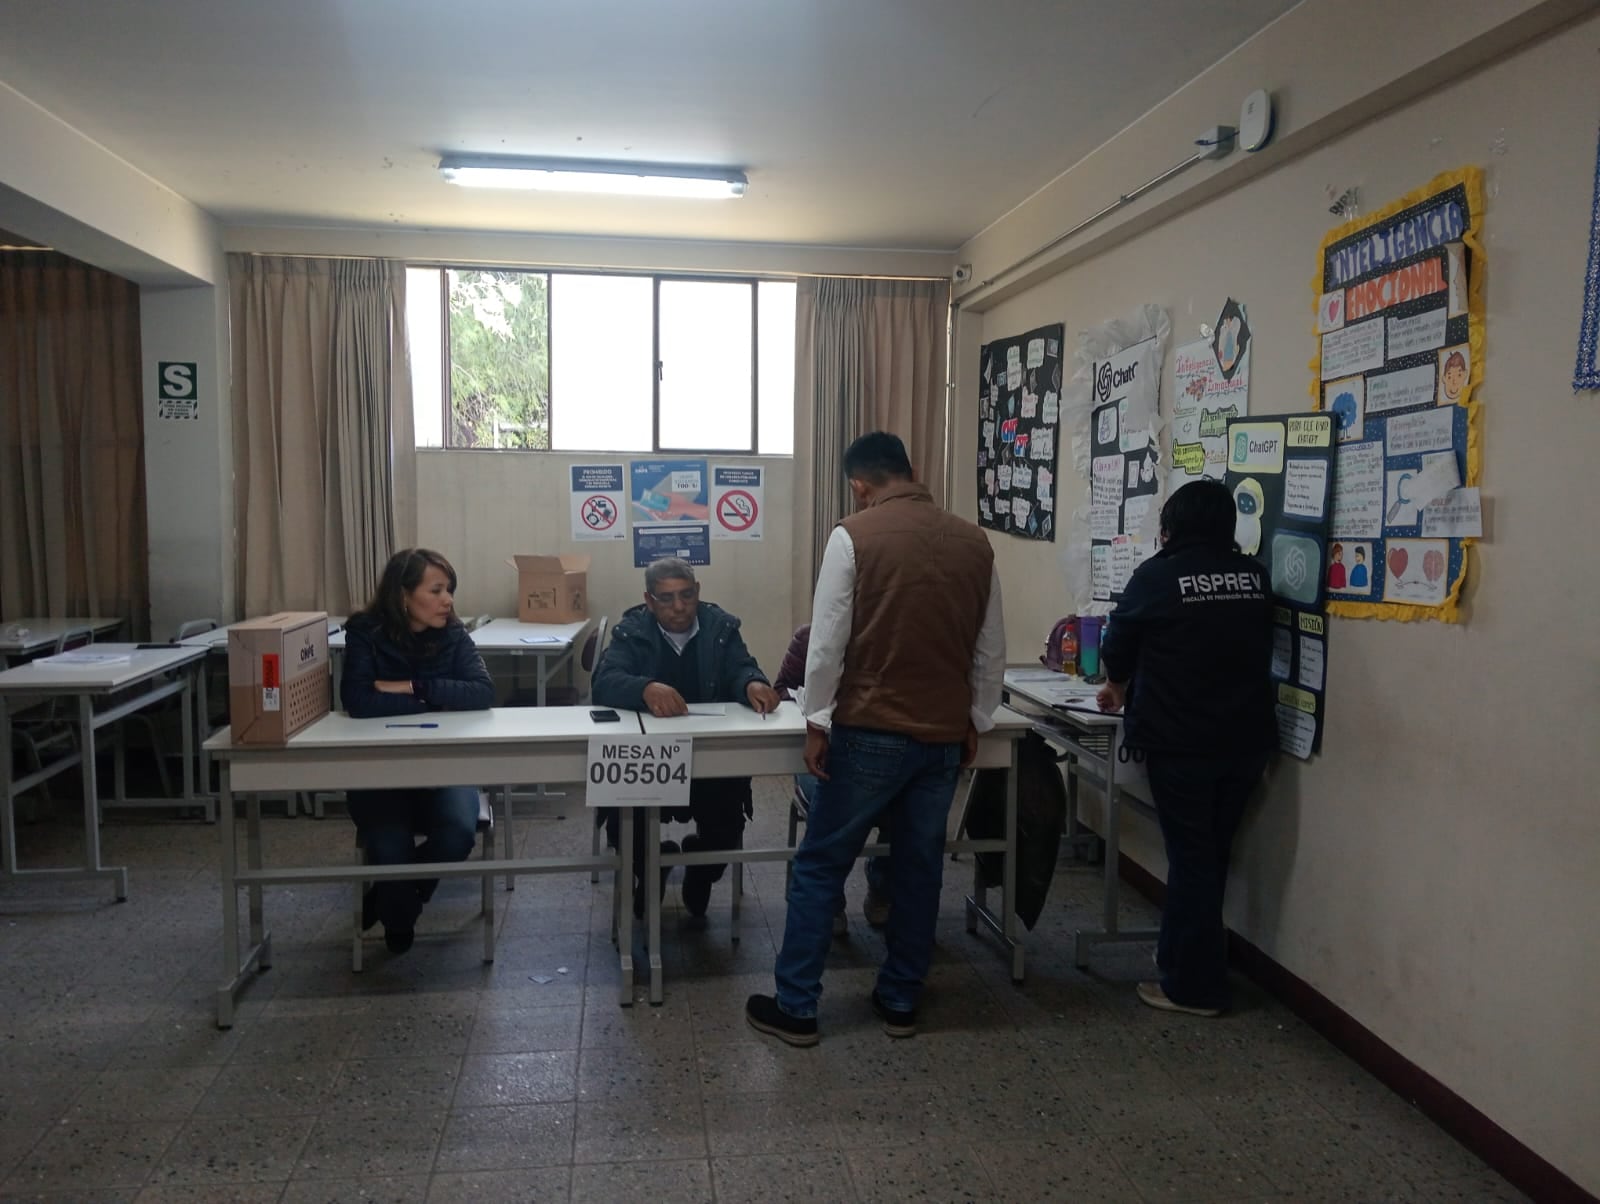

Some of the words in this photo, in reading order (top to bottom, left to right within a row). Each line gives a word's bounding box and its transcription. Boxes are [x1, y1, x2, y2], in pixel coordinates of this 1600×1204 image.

[1329, 201, 1463, 289] INTELIGENCIA
[1346, 256, 1448, 321] EMOCIONAL
[163, 364, 193, 397] S
[1249, 440, 1278, 454] ChatGPT
[1178, 573, 1261, 595] FISPREV
[300, 644, 314, 661] ONPE
[602, 744, 655, 759] MESA
[660, 744, 680, 759] Nº
[590, 762, 688, 784] 005504
